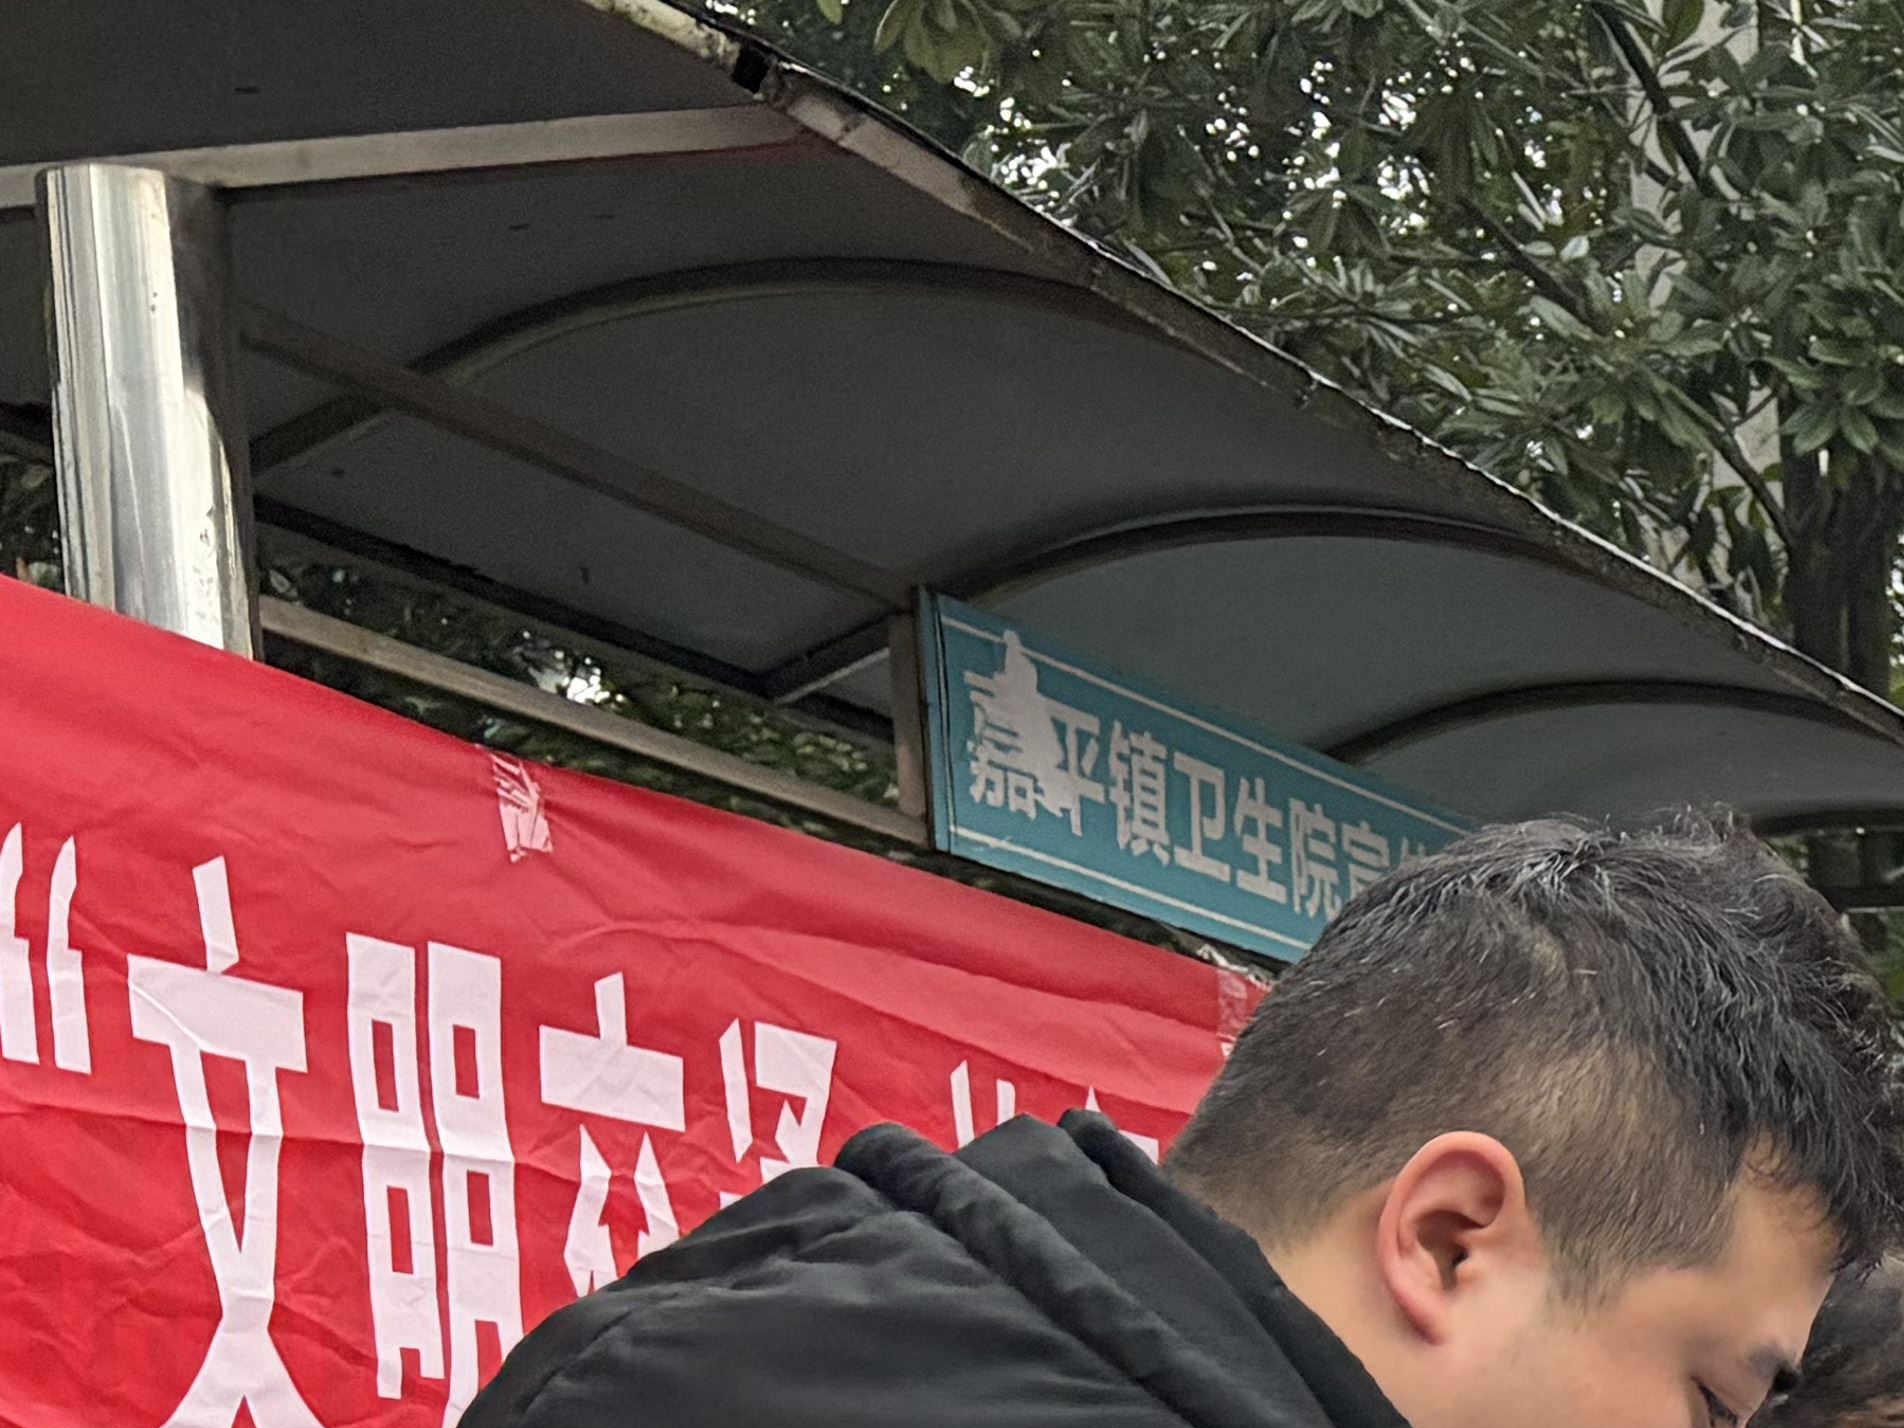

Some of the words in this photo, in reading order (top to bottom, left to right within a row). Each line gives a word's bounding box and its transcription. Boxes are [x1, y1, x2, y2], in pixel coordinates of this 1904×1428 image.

[962, 668, 1428, 920] 嘉平镇卫生院宣
